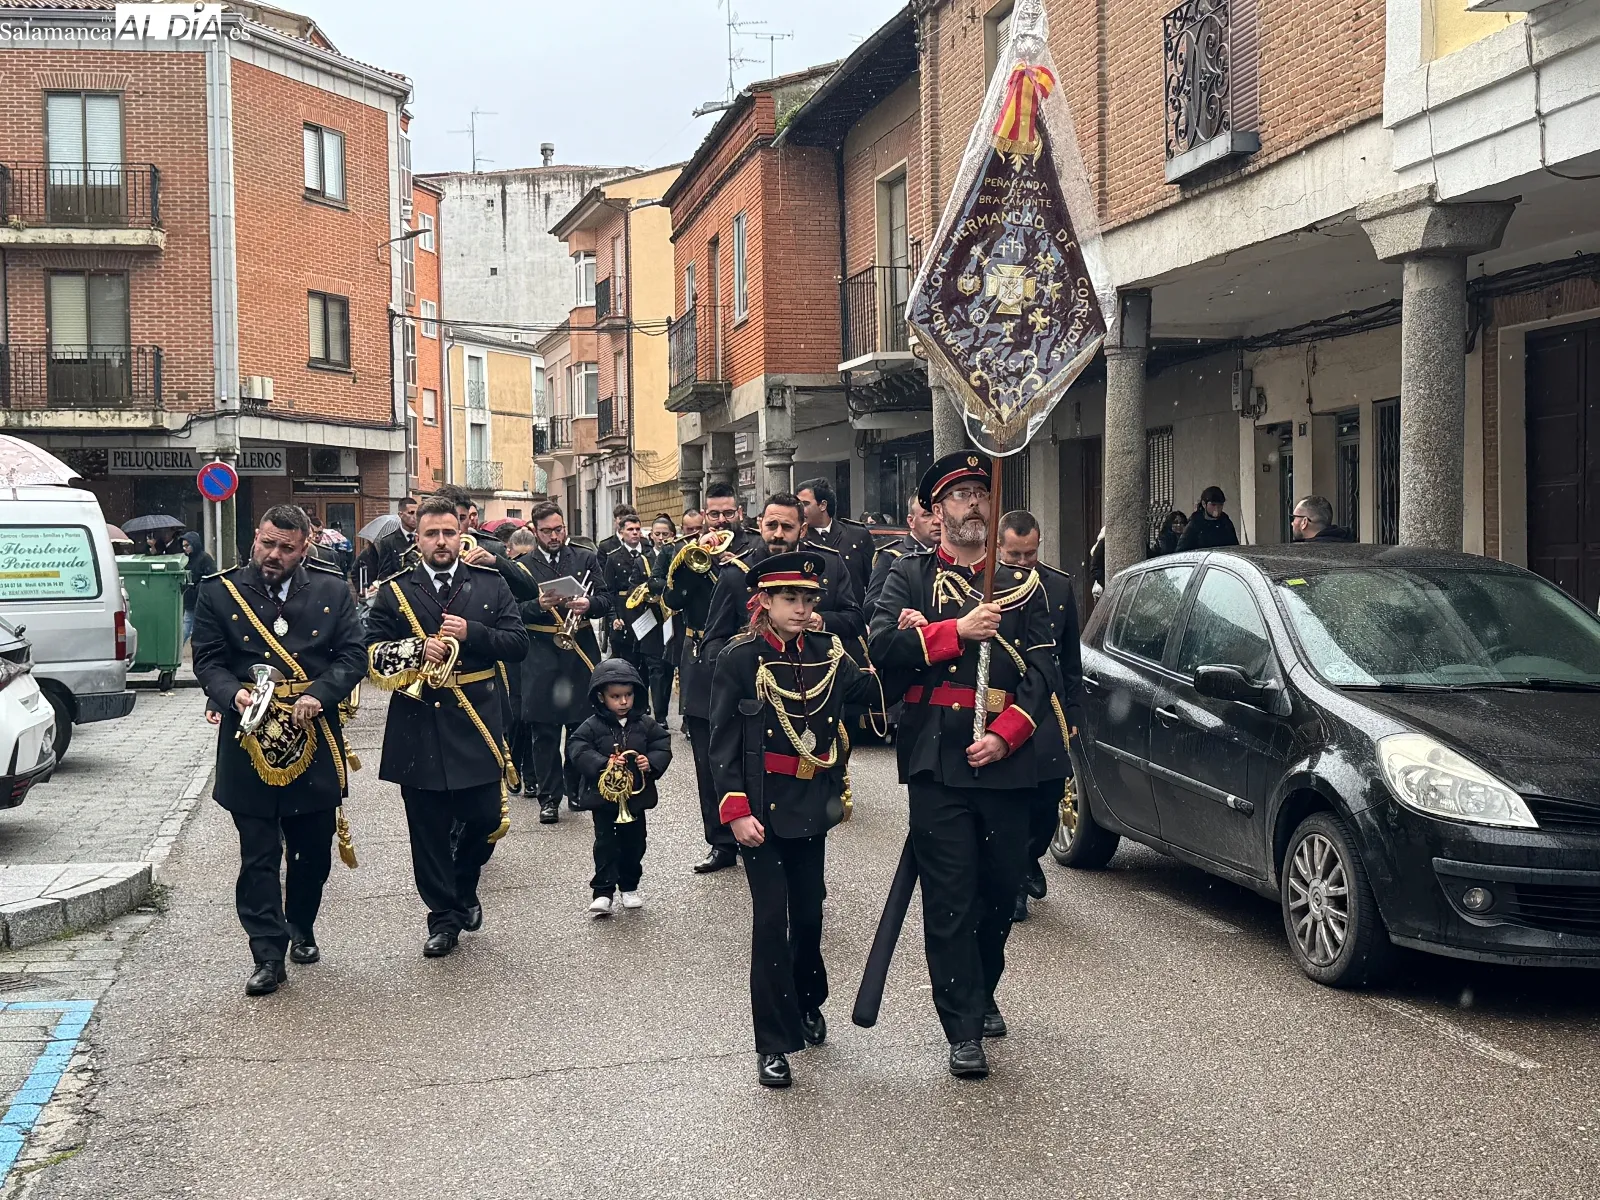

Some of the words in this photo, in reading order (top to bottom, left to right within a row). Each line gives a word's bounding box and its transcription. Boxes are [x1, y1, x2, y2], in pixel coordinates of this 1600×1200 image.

[984, 177, 1049, 191] PEÑARANDA
[979, 195, 1052, 208] BRACAMONTE
[949, 211, 1045, 245] HERMANDAD
[1055, 228, 1077, 253] DE
[113, 451, 193, 470] PELUQUERIA
[237, 452, 282, 468] LLEROS
[1, 556, 88, 569] Peñaranda
